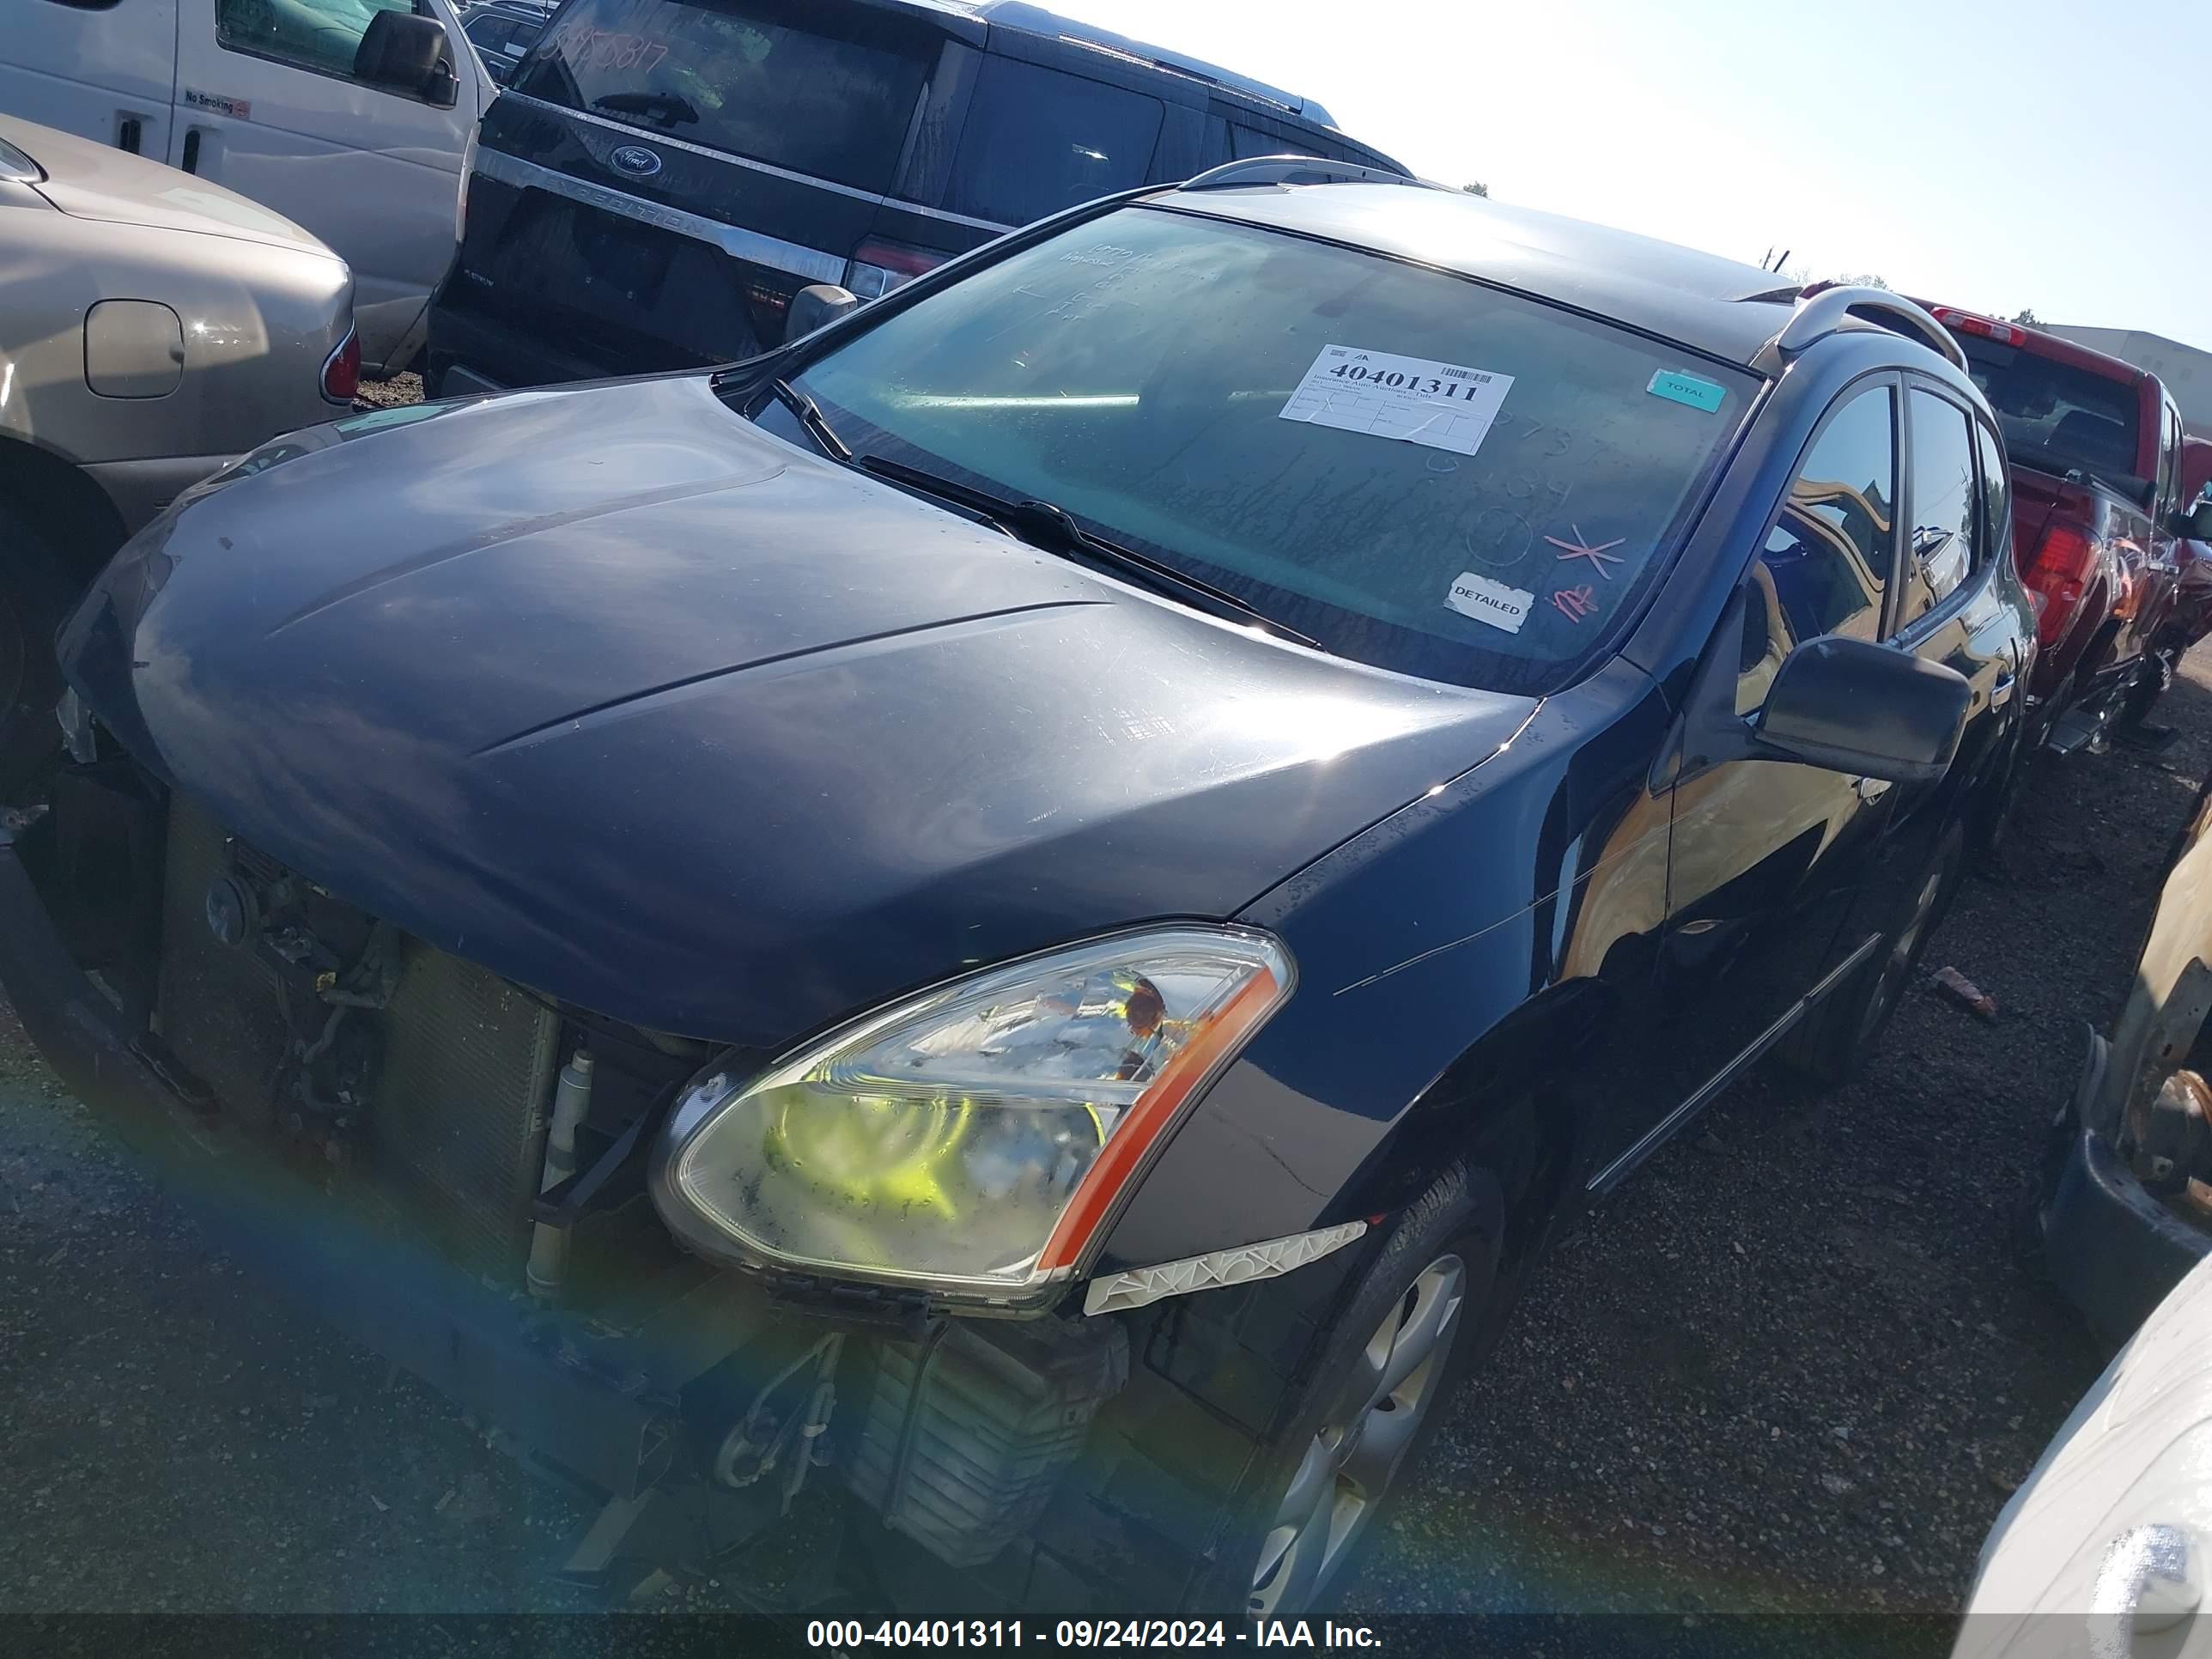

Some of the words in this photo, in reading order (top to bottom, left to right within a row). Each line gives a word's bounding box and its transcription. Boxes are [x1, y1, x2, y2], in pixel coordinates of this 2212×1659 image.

[185, 90, 197, 103] No
[199, 94, 234, 114] Smoking
[545, 177, 707, 234] EXPEDITION
[1313, 374, 1349, 385] Insurance
[1353, 380, 1371, 389] Auto
[1373, 383, 1407, 396] Auctions
[1329, 363, 1479, 402] 40401311
[1668, 382, 1704, 398] TOTAL
[1454, 586, 1521, 616] DETAILED
